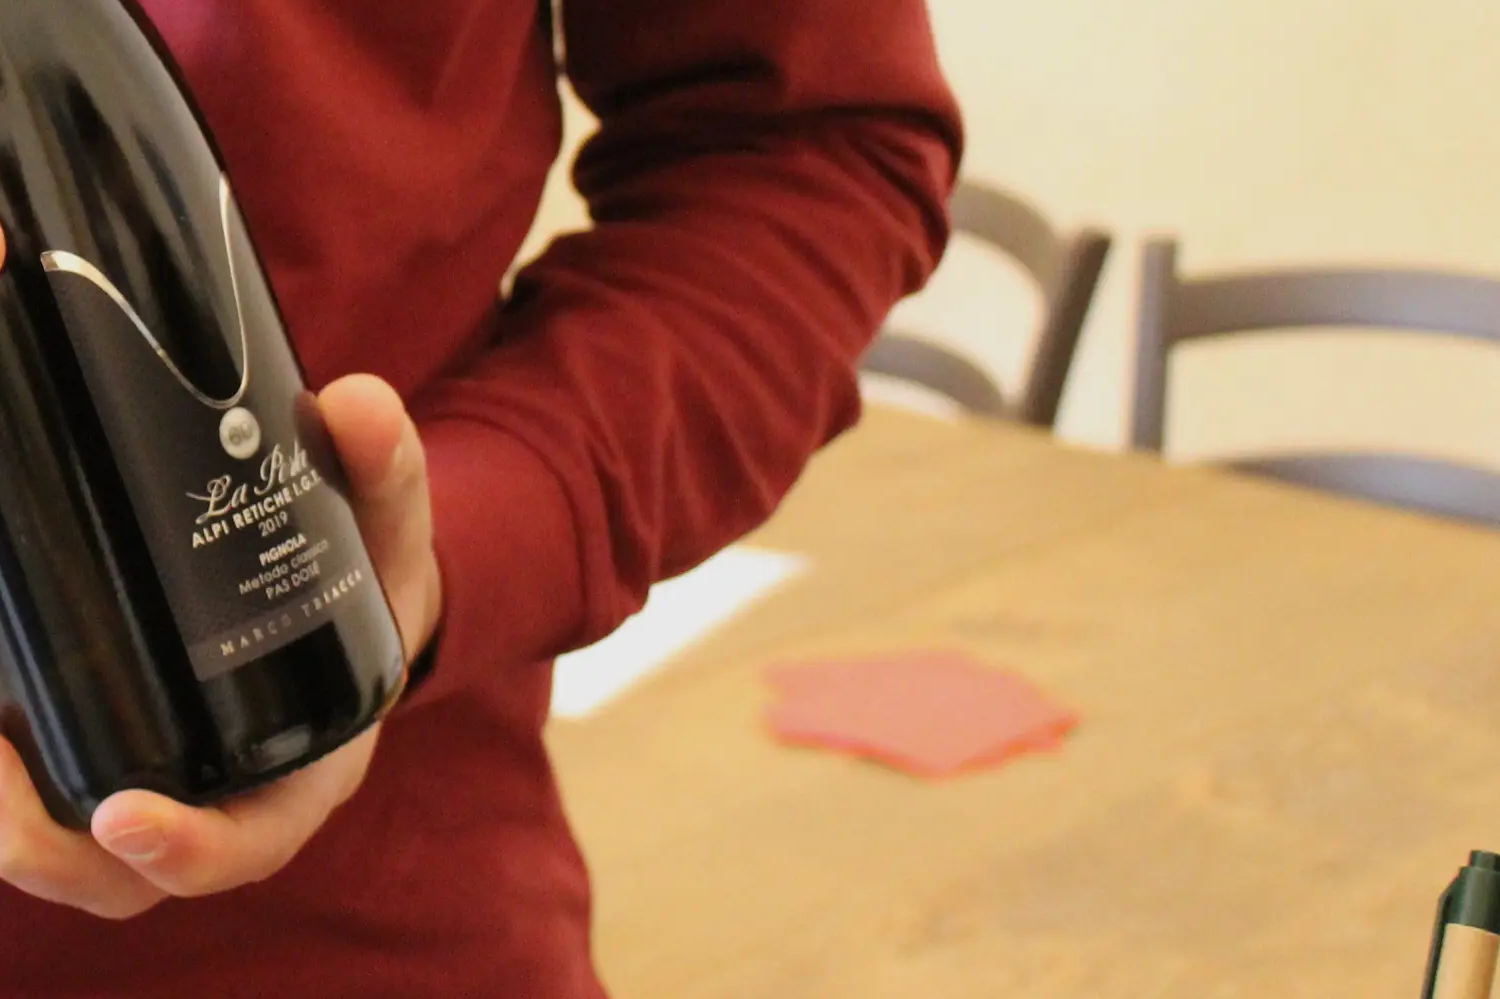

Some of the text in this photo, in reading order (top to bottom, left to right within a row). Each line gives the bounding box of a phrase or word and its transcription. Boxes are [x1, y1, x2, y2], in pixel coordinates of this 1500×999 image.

[186, 473, 247, 525] La
[191, 519, 230, 549] ALPI
[232, 487, 293, 529] RETICHE
[258, 511, 289, 538] 2019
[258, 532, 308, 567] PIGNOLA
[238, 562, 289, 595] Metodo
[265, 578, 290, 600] PAS
[220, 614, 293, 656] MARCO
